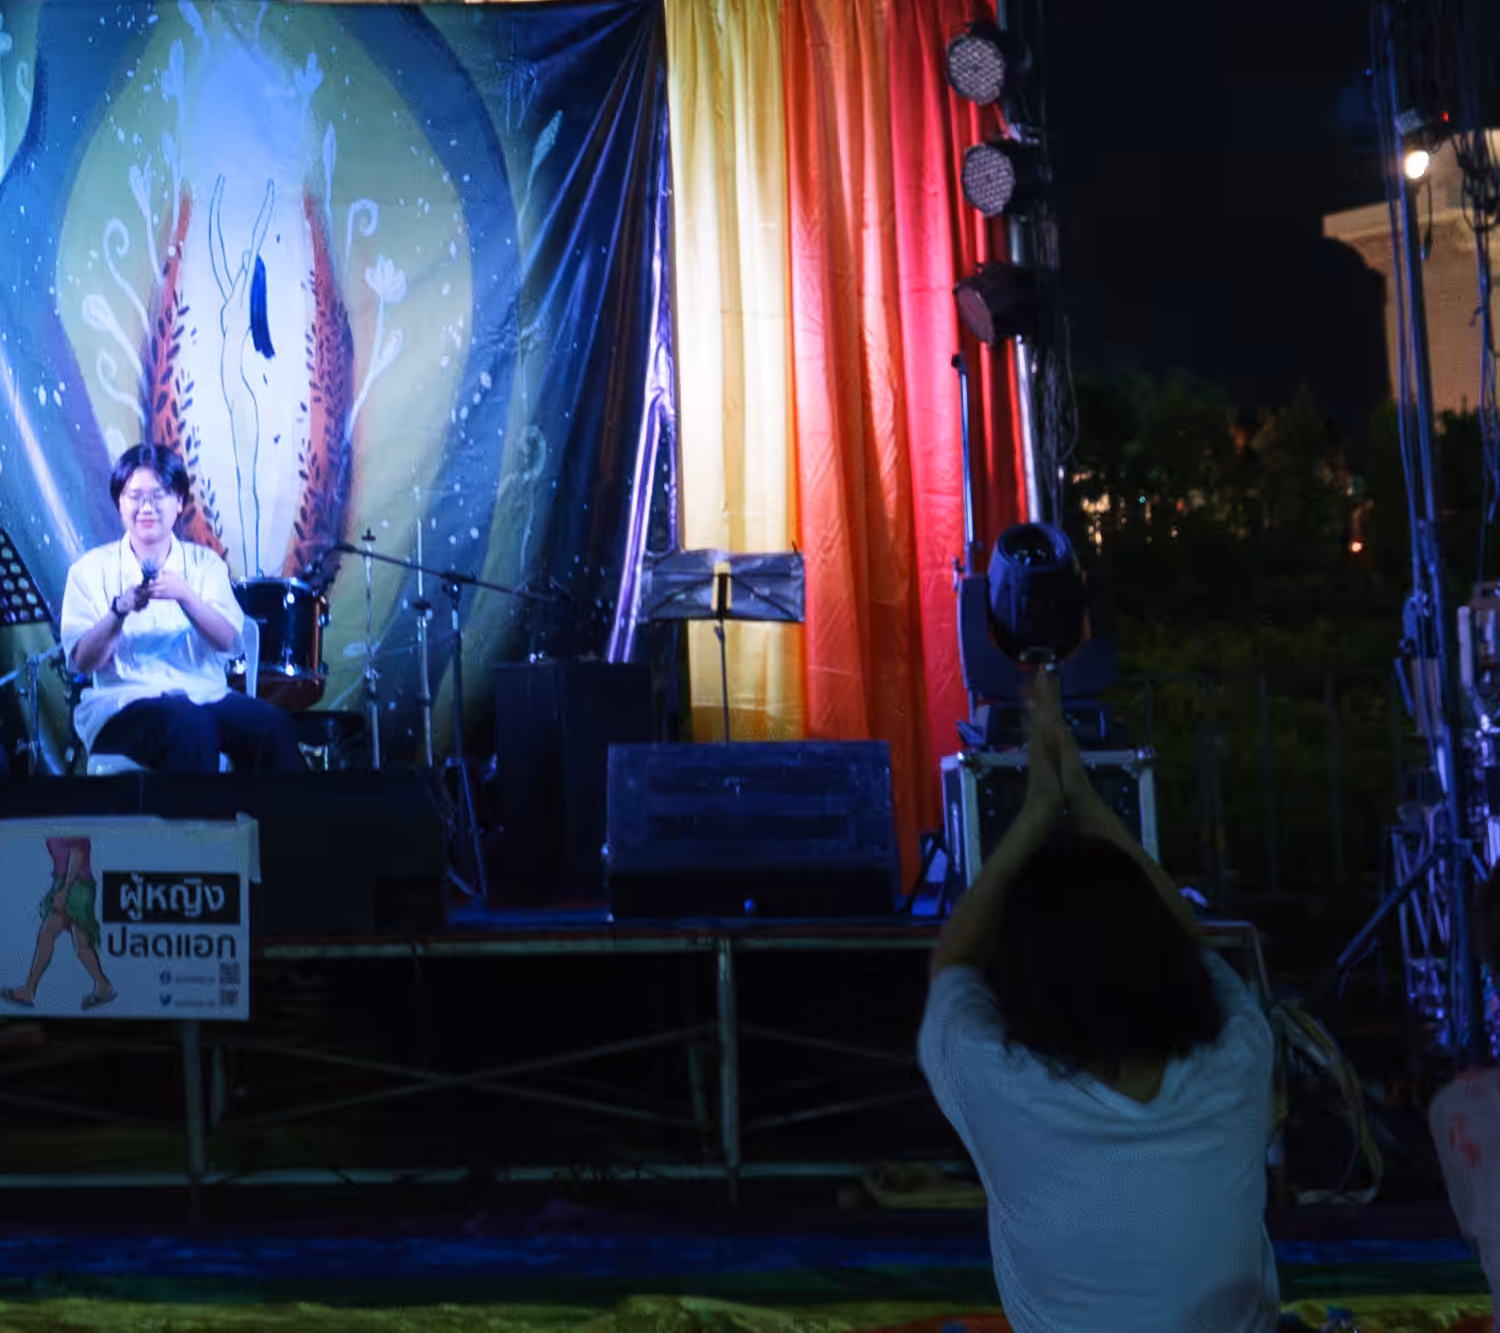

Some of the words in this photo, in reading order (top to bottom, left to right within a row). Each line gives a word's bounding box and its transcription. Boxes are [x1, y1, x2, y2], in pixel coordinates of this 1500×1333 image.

[120, 874, 224, 921] ผู้หญิง
[107, 927, 236, 958] ปลดแอก
